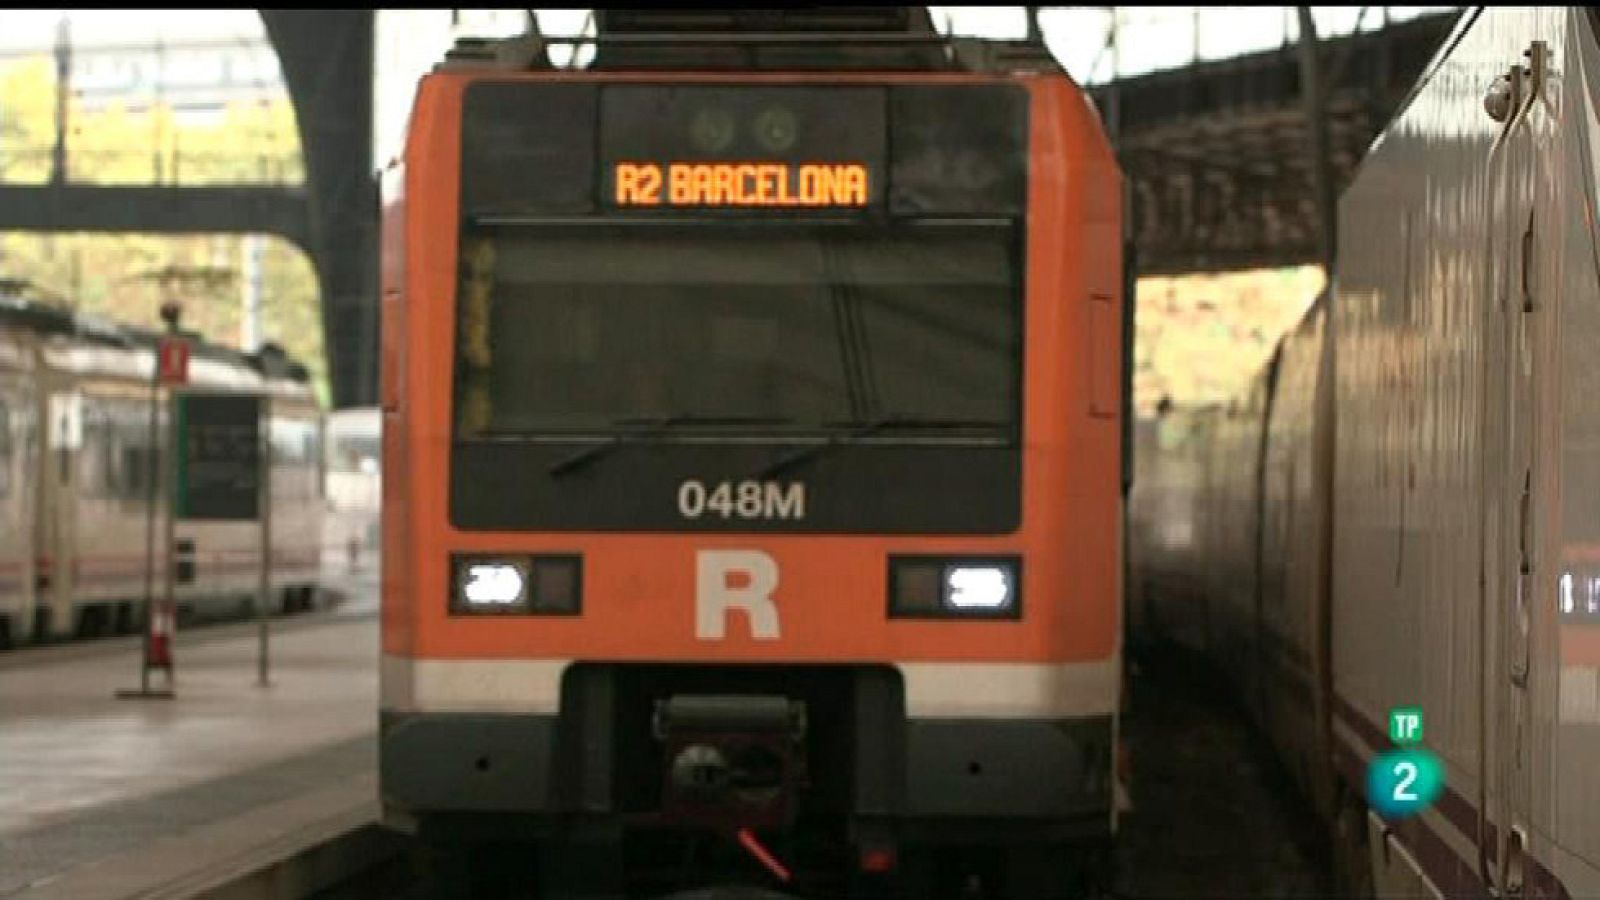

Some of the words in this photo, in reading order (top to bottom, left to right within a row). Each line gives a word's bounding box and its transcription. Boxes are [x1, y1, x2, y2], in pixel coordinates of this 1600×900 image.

[616, 163, 662, 205] R2
[669, 163, 868, 205] BARCELONA
[678, 480, 806, 519] 048M
[695, 549, 780, 640] R
